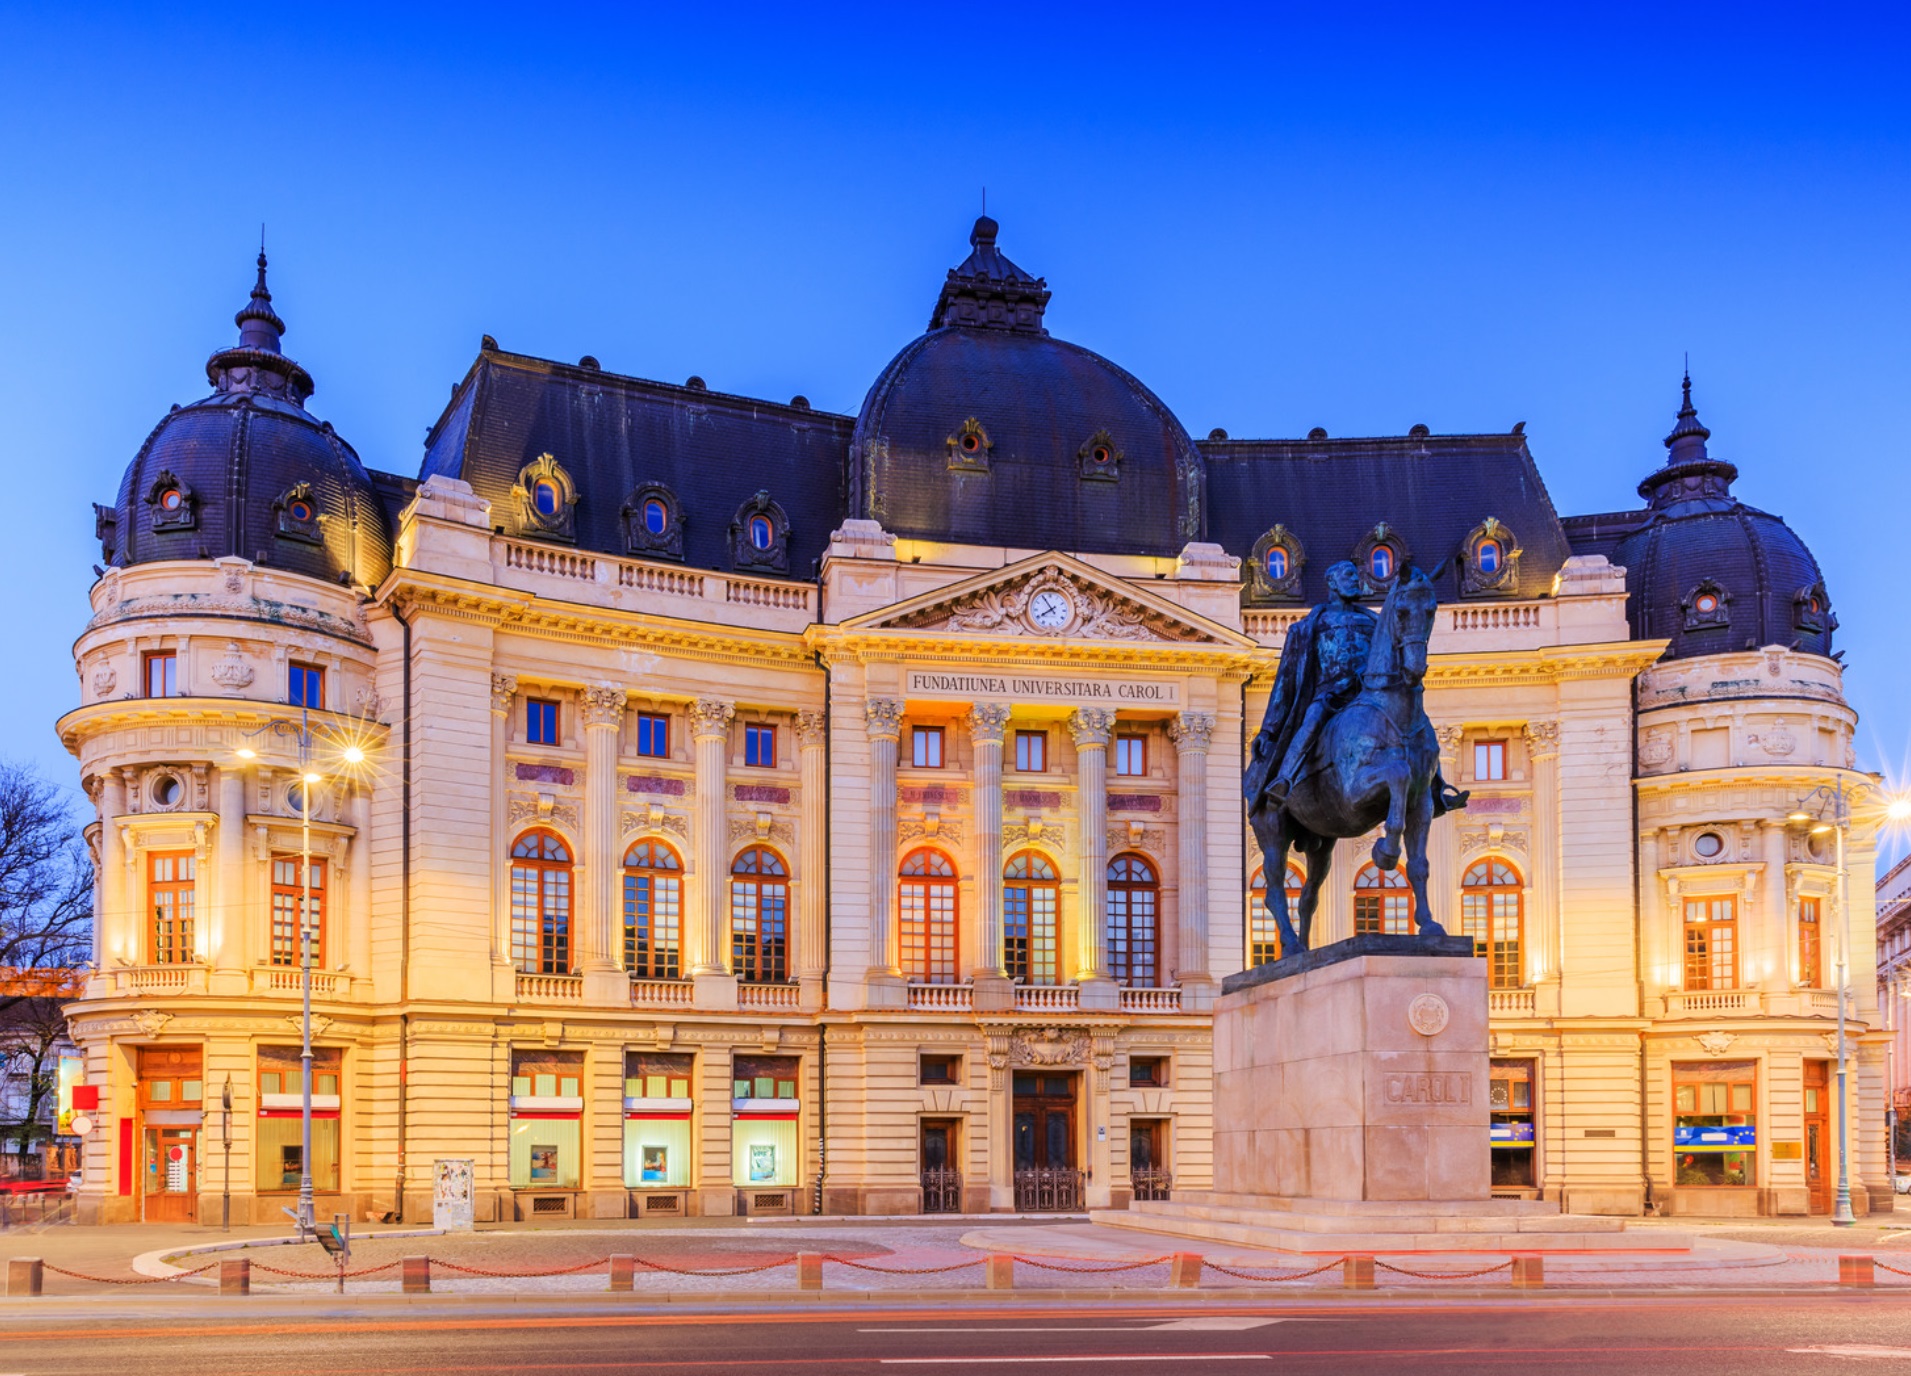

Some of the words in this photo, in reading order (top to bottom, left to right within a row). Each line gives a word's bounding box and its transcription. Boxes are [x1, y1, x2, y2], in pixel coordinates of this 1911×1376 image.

[913, 675, 1007, 693] FUNDATIUNEA
[1012, 679, 1112, 697] UNIVERSITARA
[1118, 684, 1163, 699] CAROL
[1168, 686, 1174, 699] I
[1387, 1075, 1456, 1103] CAROL
[1459, 1075, 1469, 1103] I
